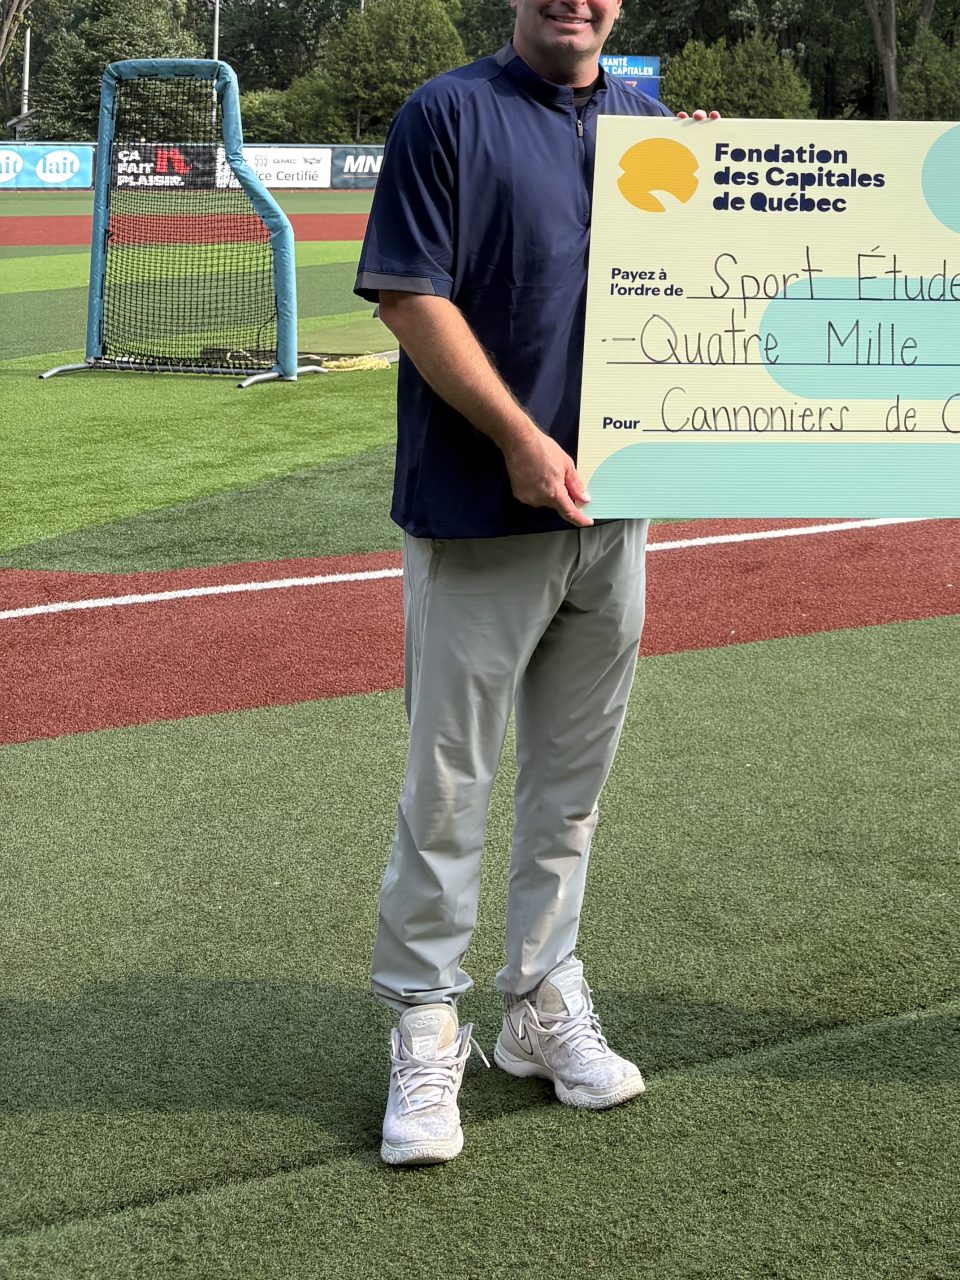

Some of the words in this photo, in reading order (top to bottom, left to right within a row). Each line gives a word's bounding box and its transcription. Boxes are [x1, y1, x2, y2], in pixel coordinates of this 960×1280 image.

[602, 57, 628, 66] SANTÉ
[612, 67, 653, 75] CAPITALES
[715, 143, 847, 164] Fondation
[43, 157, 77, 173] lait
[276, 170, 319, 181] Certifié
[713, 167, 759, 186] des
[765, 167, 885, 191] Capitales
[712, 192, 745, 211] de
[750, 191, 847, 212] Québec
[611, 268, 655, 283] Payez
[658, 268, 667, 280] à
[710, 245, 823, 319] Sport
[610, 284, 660, 297] l'ordre
[665, 285, 684, 296] de
[640, 308, 779, 366] Quatre
[828, 320, 918, 366] Mille
[662, 387, 849, 433] Cannoniers
[885, 394, 917, 433] de
[602, 417, 640, 430] Pour
